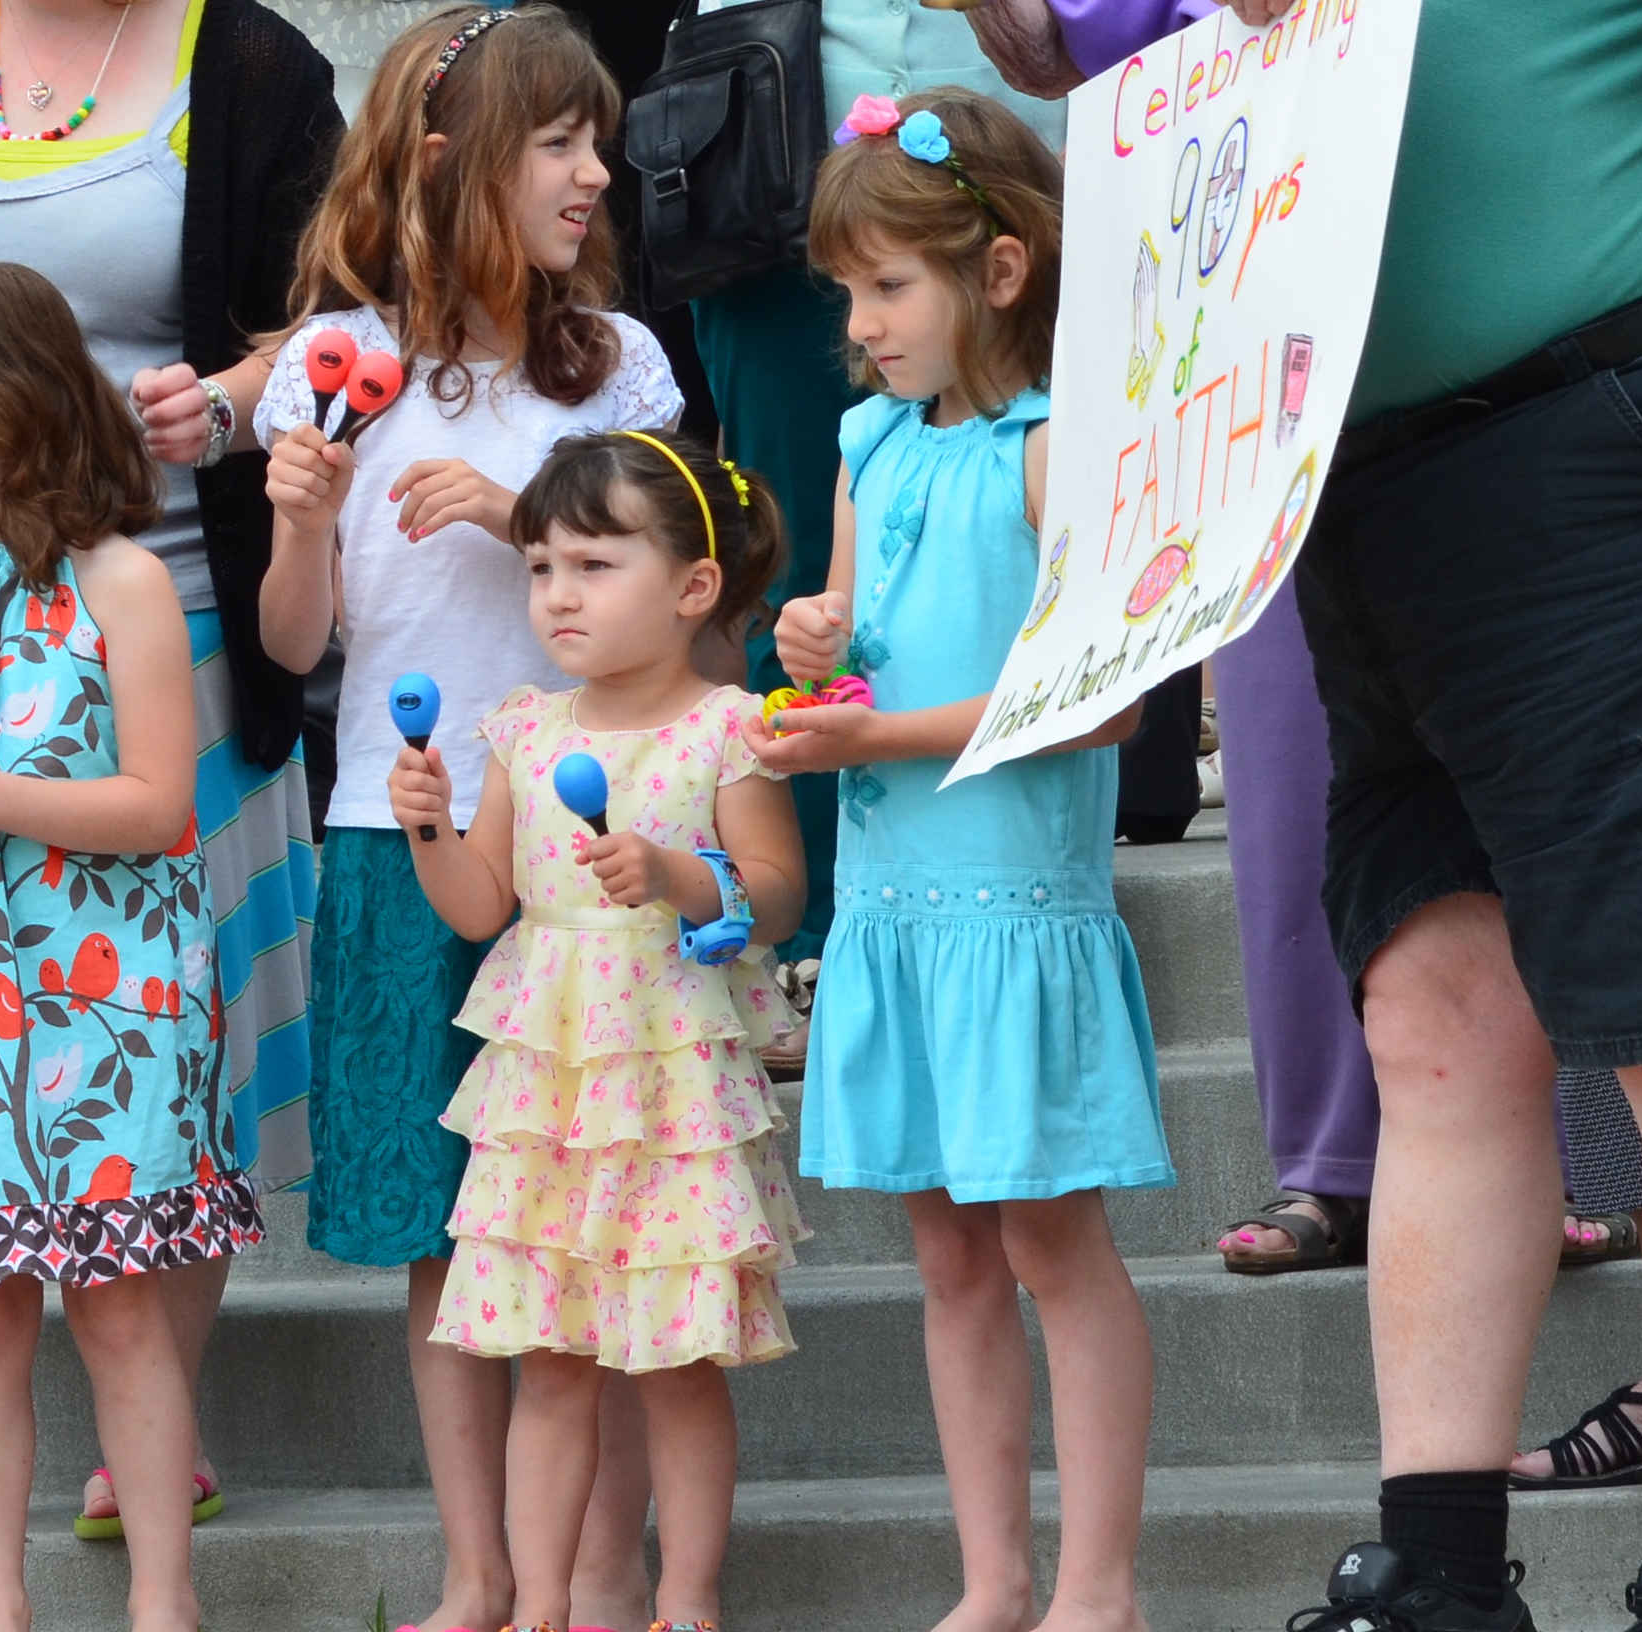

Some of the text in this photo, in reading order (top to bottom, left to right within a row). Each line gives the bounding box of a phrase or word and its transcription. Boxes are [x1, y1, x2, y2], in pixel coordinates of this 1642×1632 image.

[1171, 115, 1305, 303] 90 yrs
[1173, 306, 1204, 397] of
[1102, 339, 1268, 574] FAITH
[974, 664, 1066, 754] United
[1057, 627, 1131, 712] Church
[1132, 603, 1173, 673] of
[1160, 565, 1242, 659] Canada
